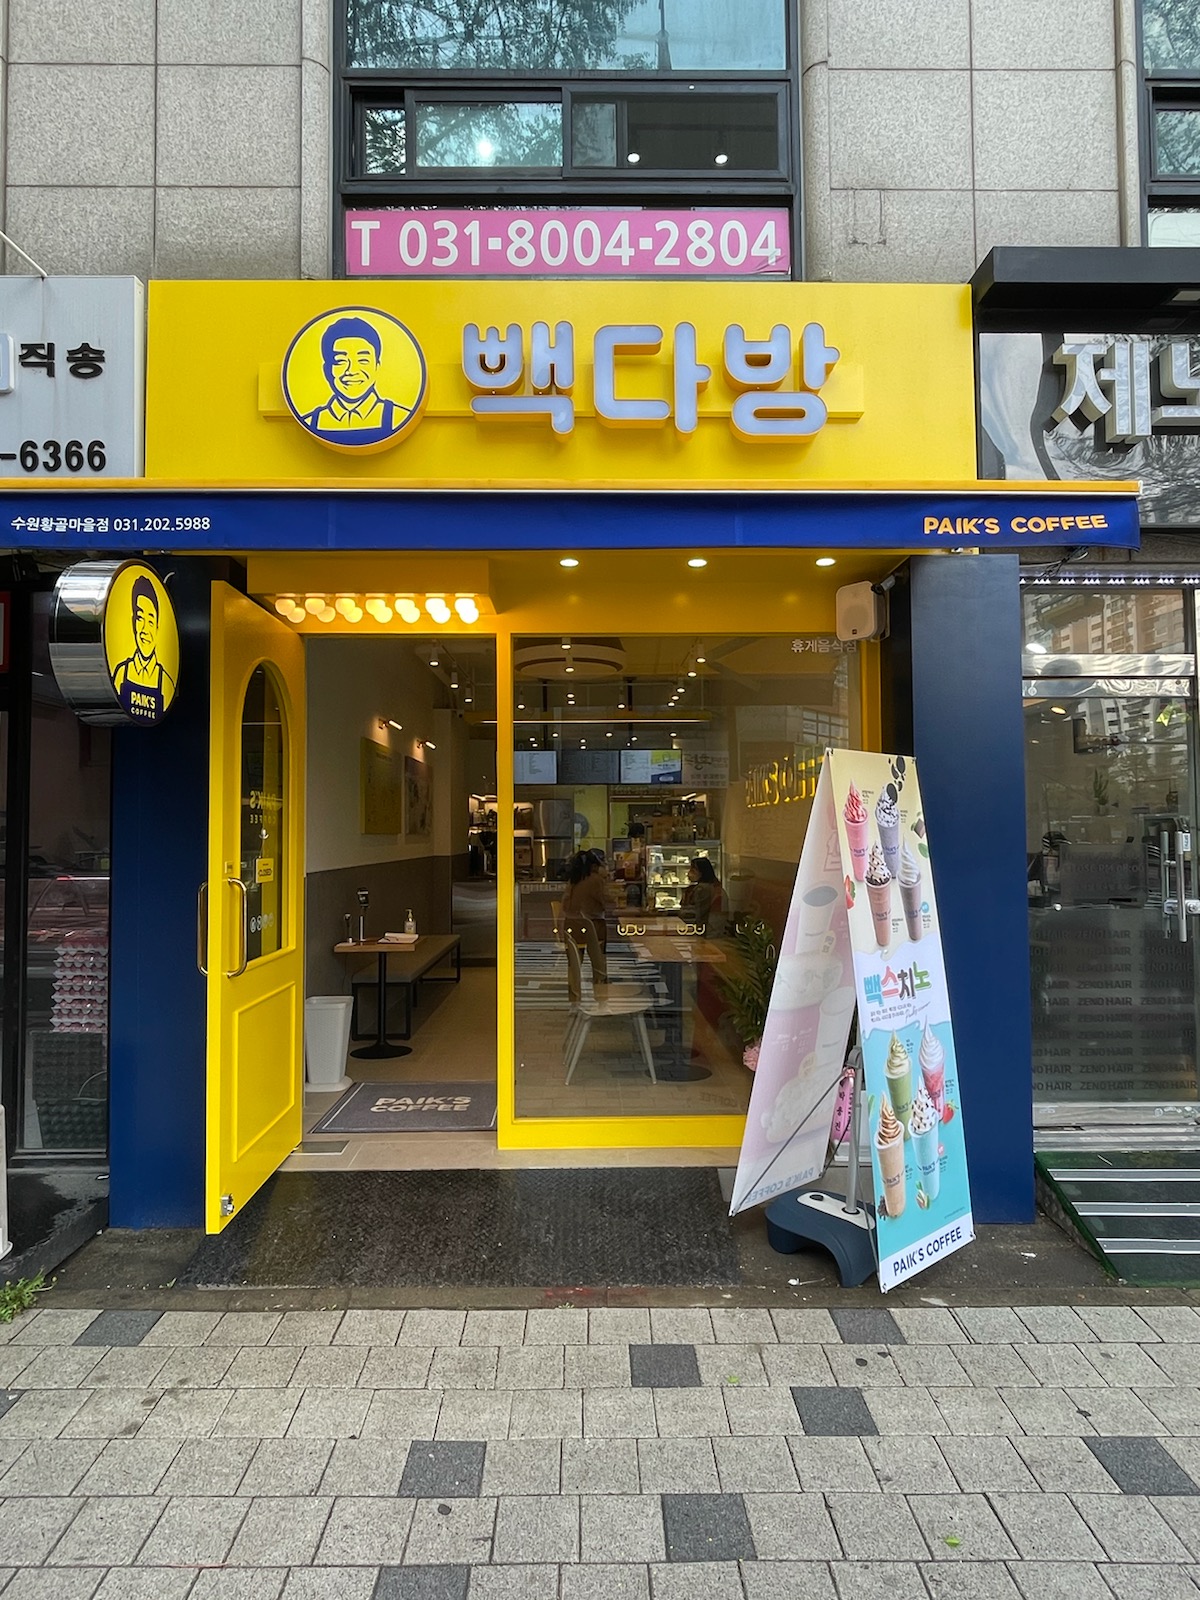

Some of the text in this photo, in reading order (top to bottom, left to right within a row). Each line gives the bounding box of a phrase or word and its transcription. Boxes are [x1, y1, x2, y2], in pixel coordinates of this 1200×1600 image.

[351, 219, 782, 267] T 031-8004-2804
[18, 342, 106, 379] 직송
[462, 319, 841, 441] 빽다방
[10, 516, 211, 533] 수원황골마을점 031.202.5988
[923, 514, 1109, 535] PAIK'S COFFEE
[130, 691, 156, 710] PAIK'S
[130, 706, 156, 719] COFFEE
[863, 961, 932, 1007] 빽스치노
[369, 1104, 471, 1113] COFFEE
[374, 1096, 472, 1106] PAIK'S
[893, 1226, 962, 1277] PAIK'S COFFEE
